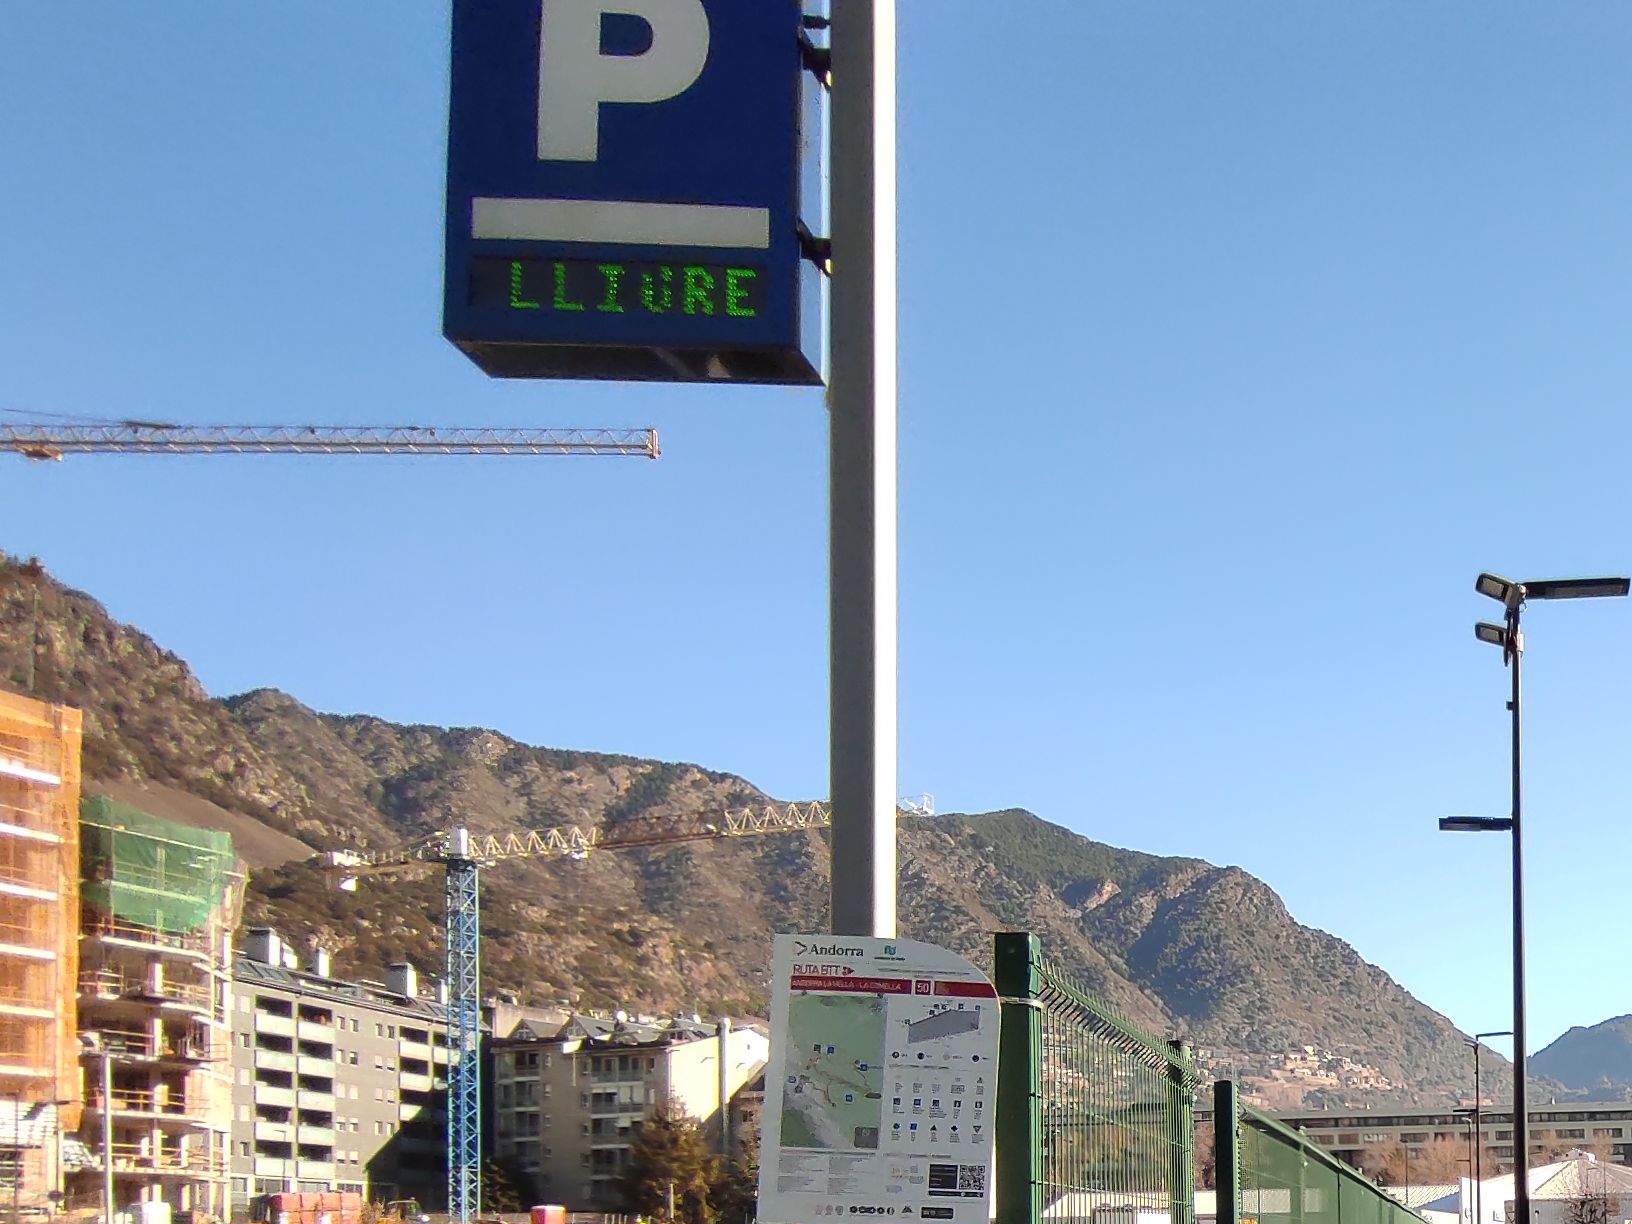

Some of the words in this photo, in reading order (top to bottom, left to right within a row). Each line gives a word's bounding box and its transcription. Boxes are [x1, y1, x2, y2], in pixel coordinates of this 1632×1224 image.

[536, 0, 711, 162] P
[510, 260, 758, 318] LLIURE
[809, 943, 864, 957] Andorra
[793, 964, 819, 975] RUTA
[917, 983, 929, 994] 50
